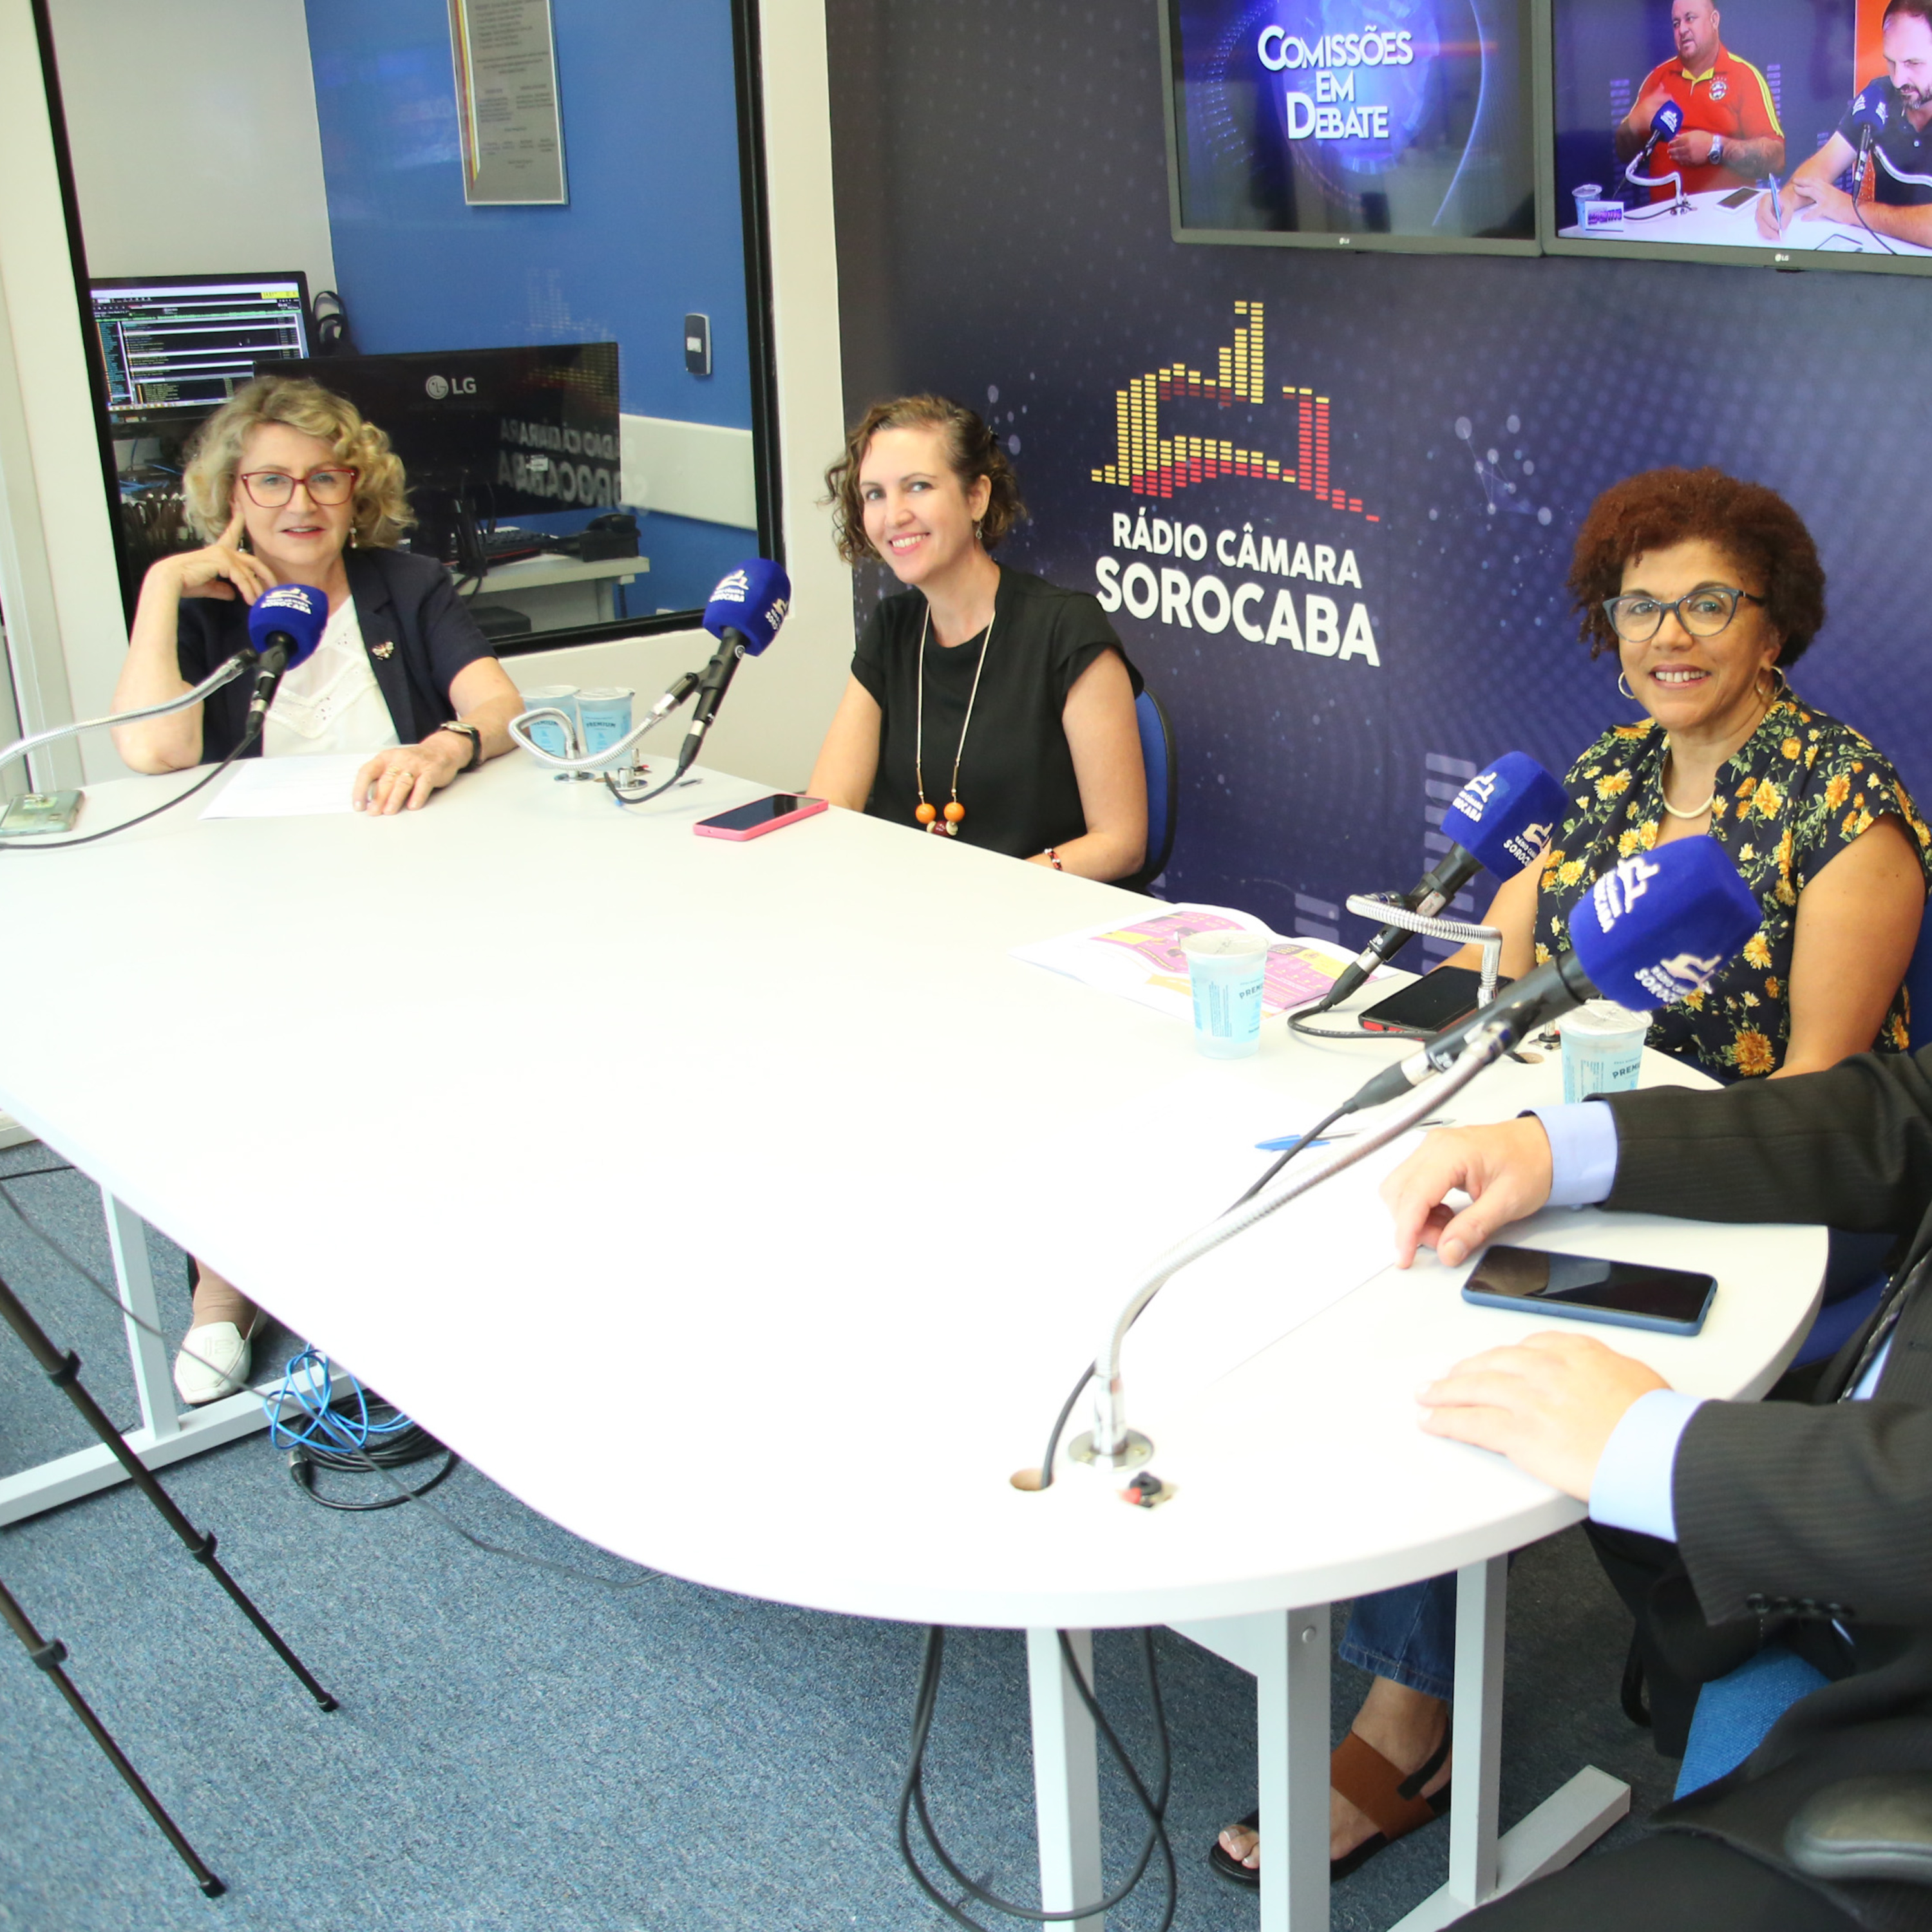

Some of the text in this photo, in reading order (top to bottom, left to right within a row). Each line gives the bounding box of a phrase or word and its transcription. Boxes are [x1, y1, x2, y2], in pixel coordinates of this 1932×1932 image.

[1258, 25, 1414, 71] COMISSÕES
[1316, 70, 1354, 102] EM
[1287, 92, 1388, 139] DEBATE
[451, 377, 477, 394] LG
[1113, 507, 1363, 589] RÁDIO CÂMARA
[1095, 556, 1381, 667] SOROCABA
